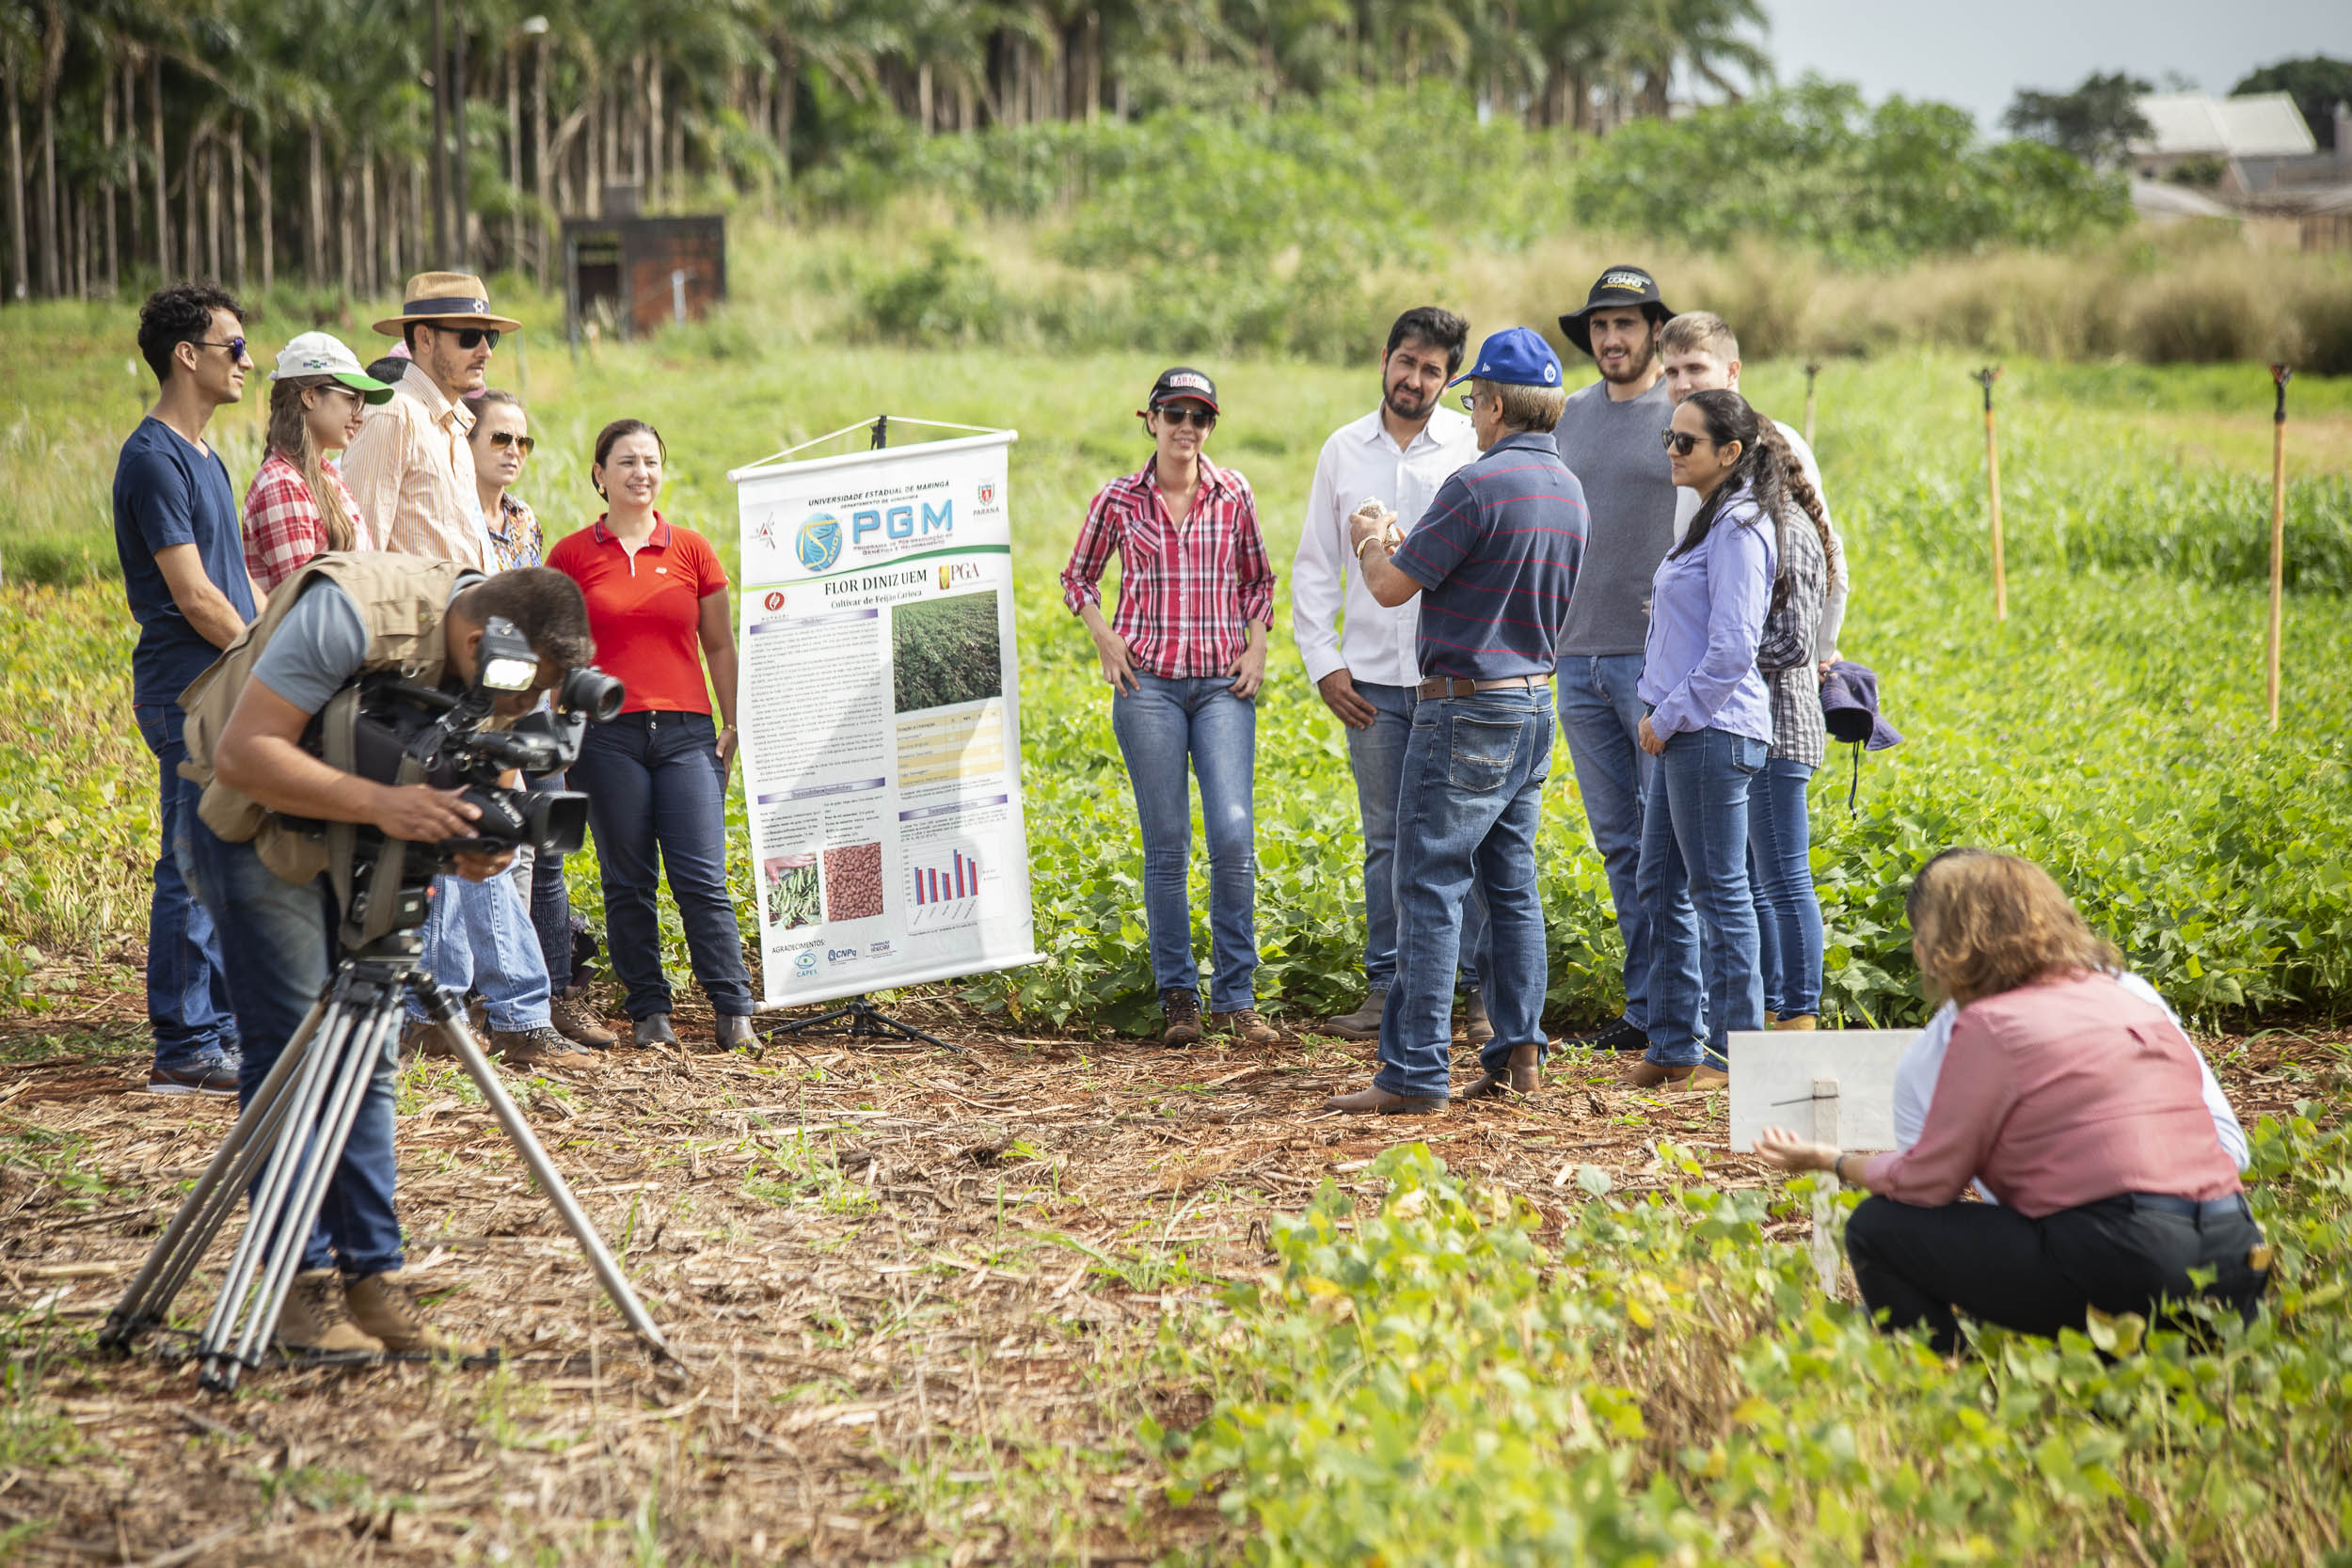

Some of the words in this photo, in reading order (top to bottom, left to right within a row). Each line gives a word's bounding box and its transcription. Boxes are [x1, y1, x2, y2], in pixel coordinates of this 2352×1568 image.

[808, 493, 863, 506] UNIVERSIDADE
[865, 486, 902, 499] ESTADUAL
[905, 484, 914, 493] DE
[916, 479, 949, 491] MARINGÁ
[852, 499, 953, 545] PGM
[950, 562, 979, 580] PGA
[824, 578, 858, 595] FLOR
[863, 574, 898, 591] DINIZ
[901, 569, 927, 583] UEM
[831, 599, 861, 610] Cultivar
[864, 595, 873, 605] de
[875, 594, 896, 604] Feijão
[897, 589, 922, 600] Carioca
[835, 948, 857, 958] CNPq
[797, 969, 818, 977] CAPES
